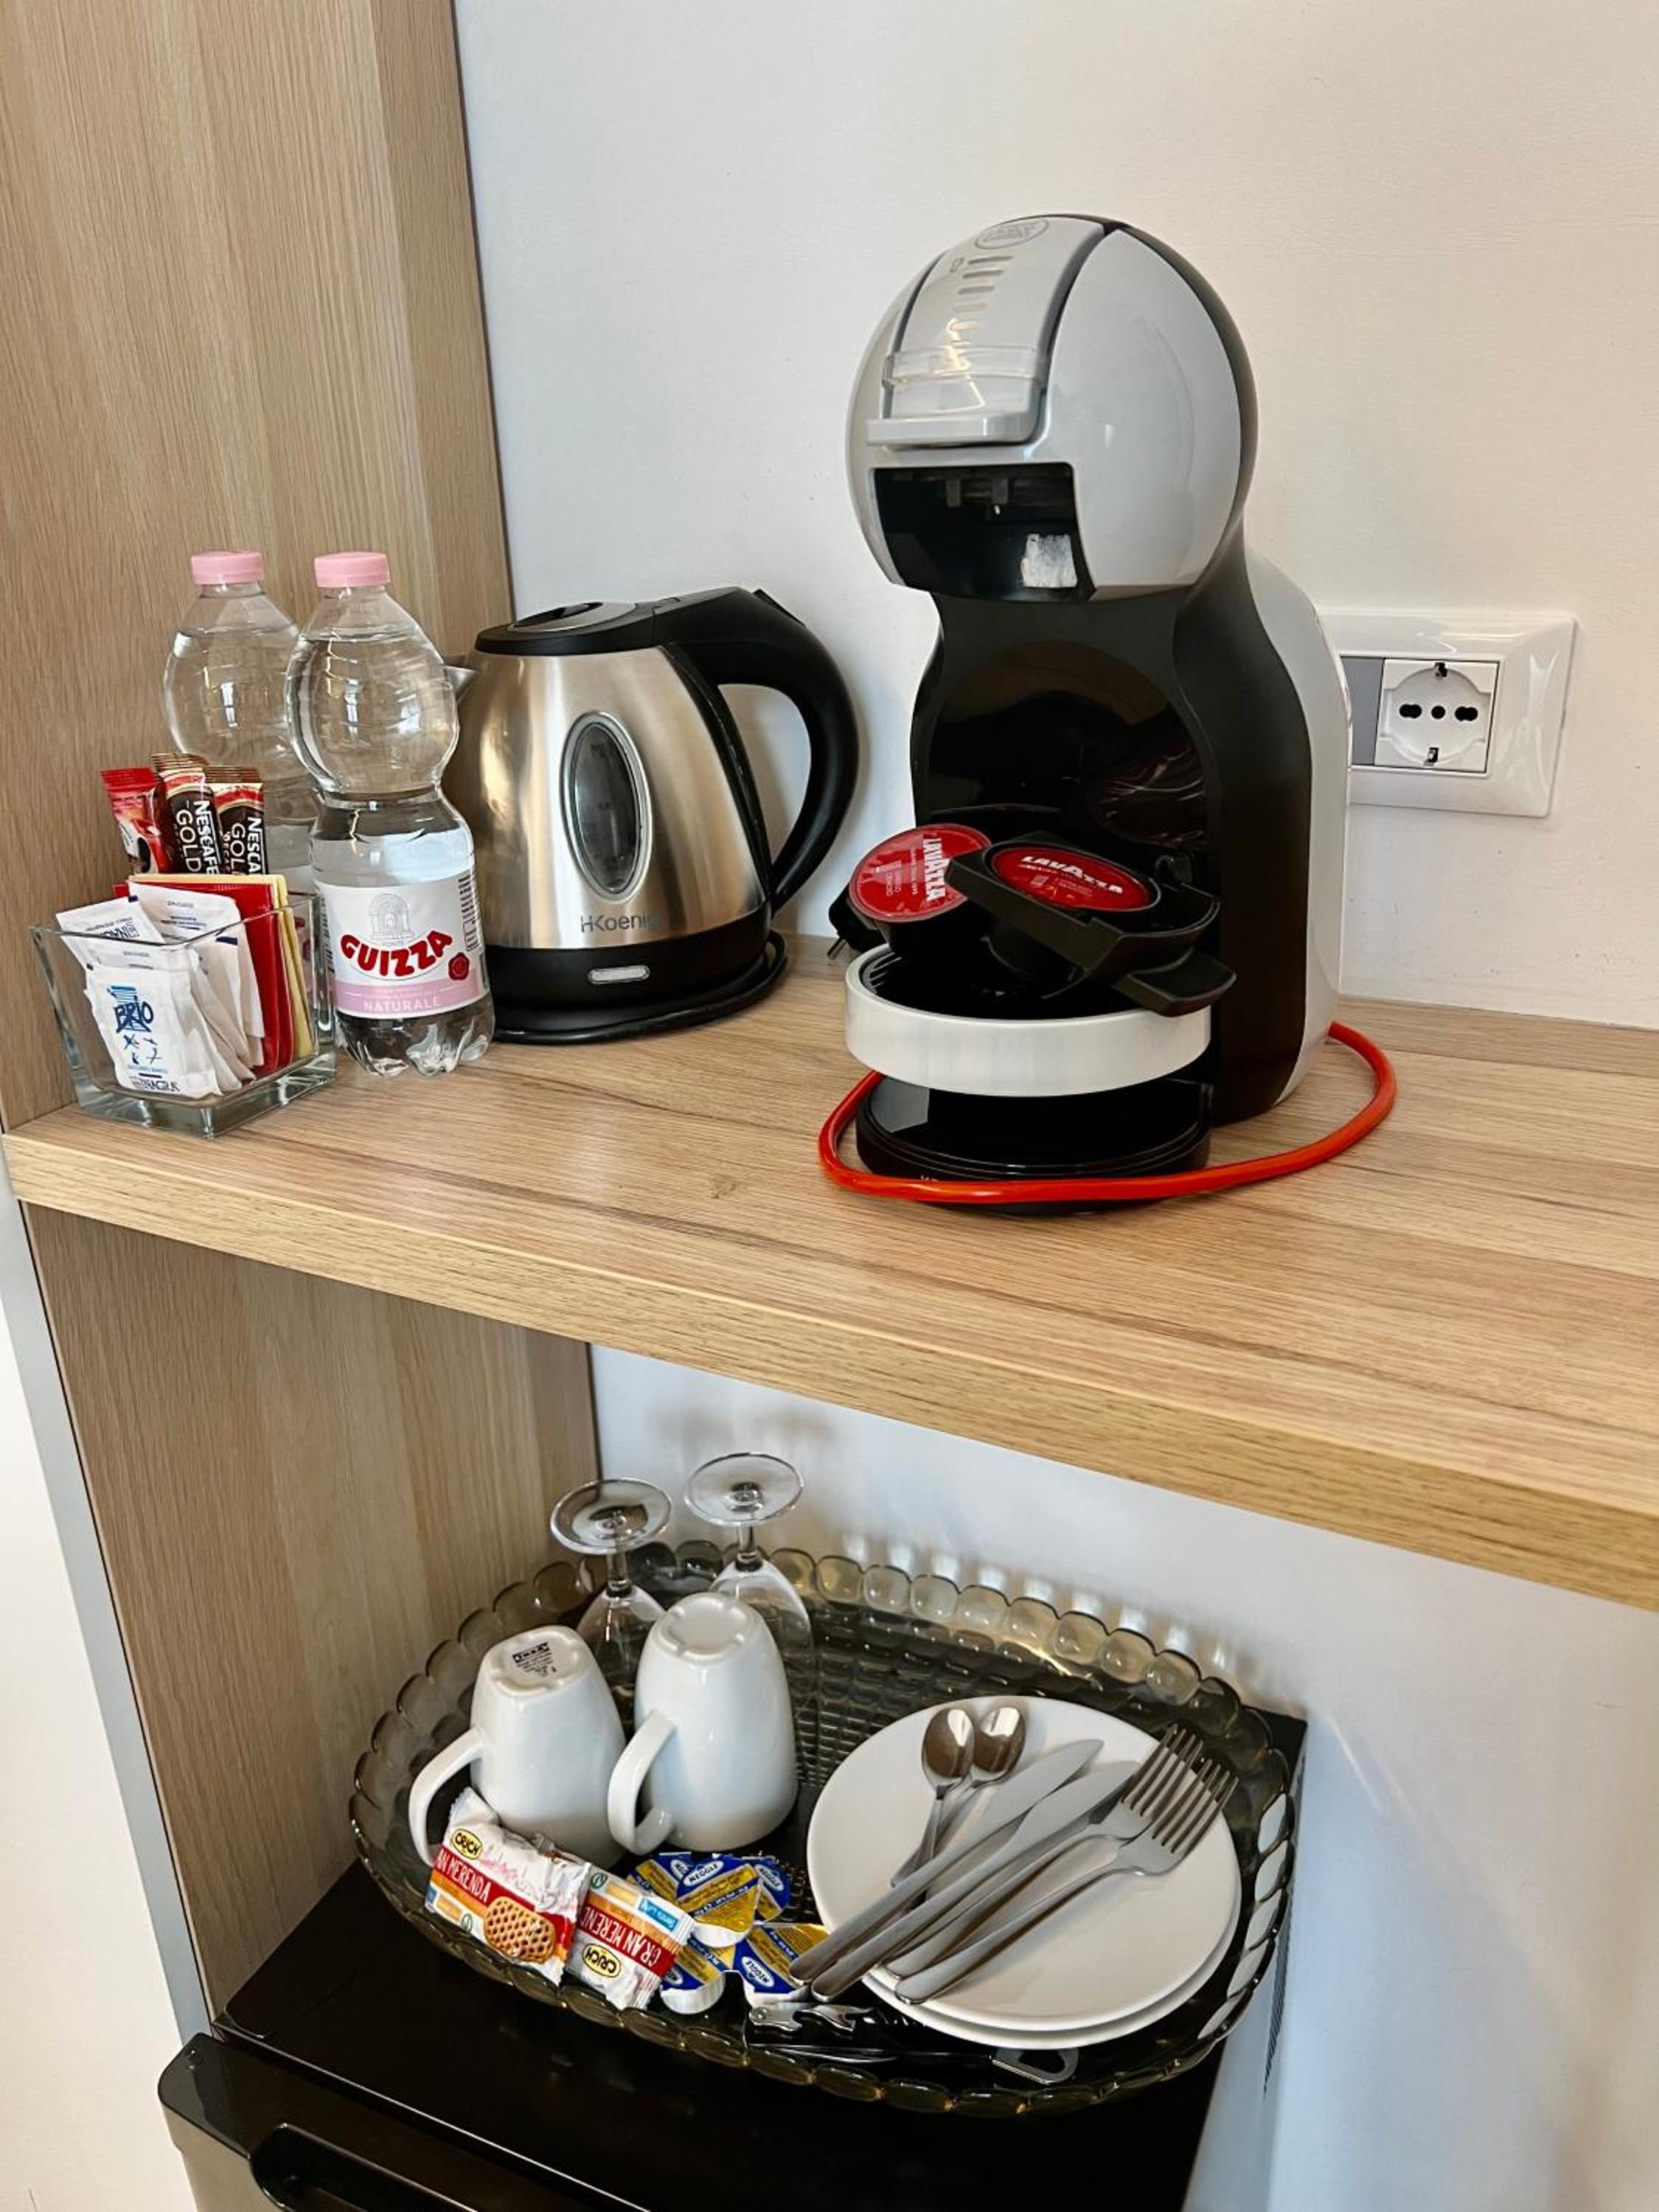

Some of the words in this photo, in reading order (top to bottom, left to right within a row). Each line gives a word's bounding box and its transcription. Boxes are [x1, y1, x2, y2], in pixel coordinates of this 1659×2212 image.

[176, 810, 202, 872] GOLD
[229, 822, 246, 874] GOL
[922, 838, 950, 902] LAVAZZA
[1020, 855, 1124, 894] LAVAZZA
[341, 930, 453, 977] GUIZZA
[454, 1832, 480, 1856] CRICH
[446, 1856, 492, 1903] MERENDA
[688, 1863, 717, 1883] MEGGLE
[585, 1948, 617, 1974] CRICH
[623, 1932, 661, 1967] GRAN
